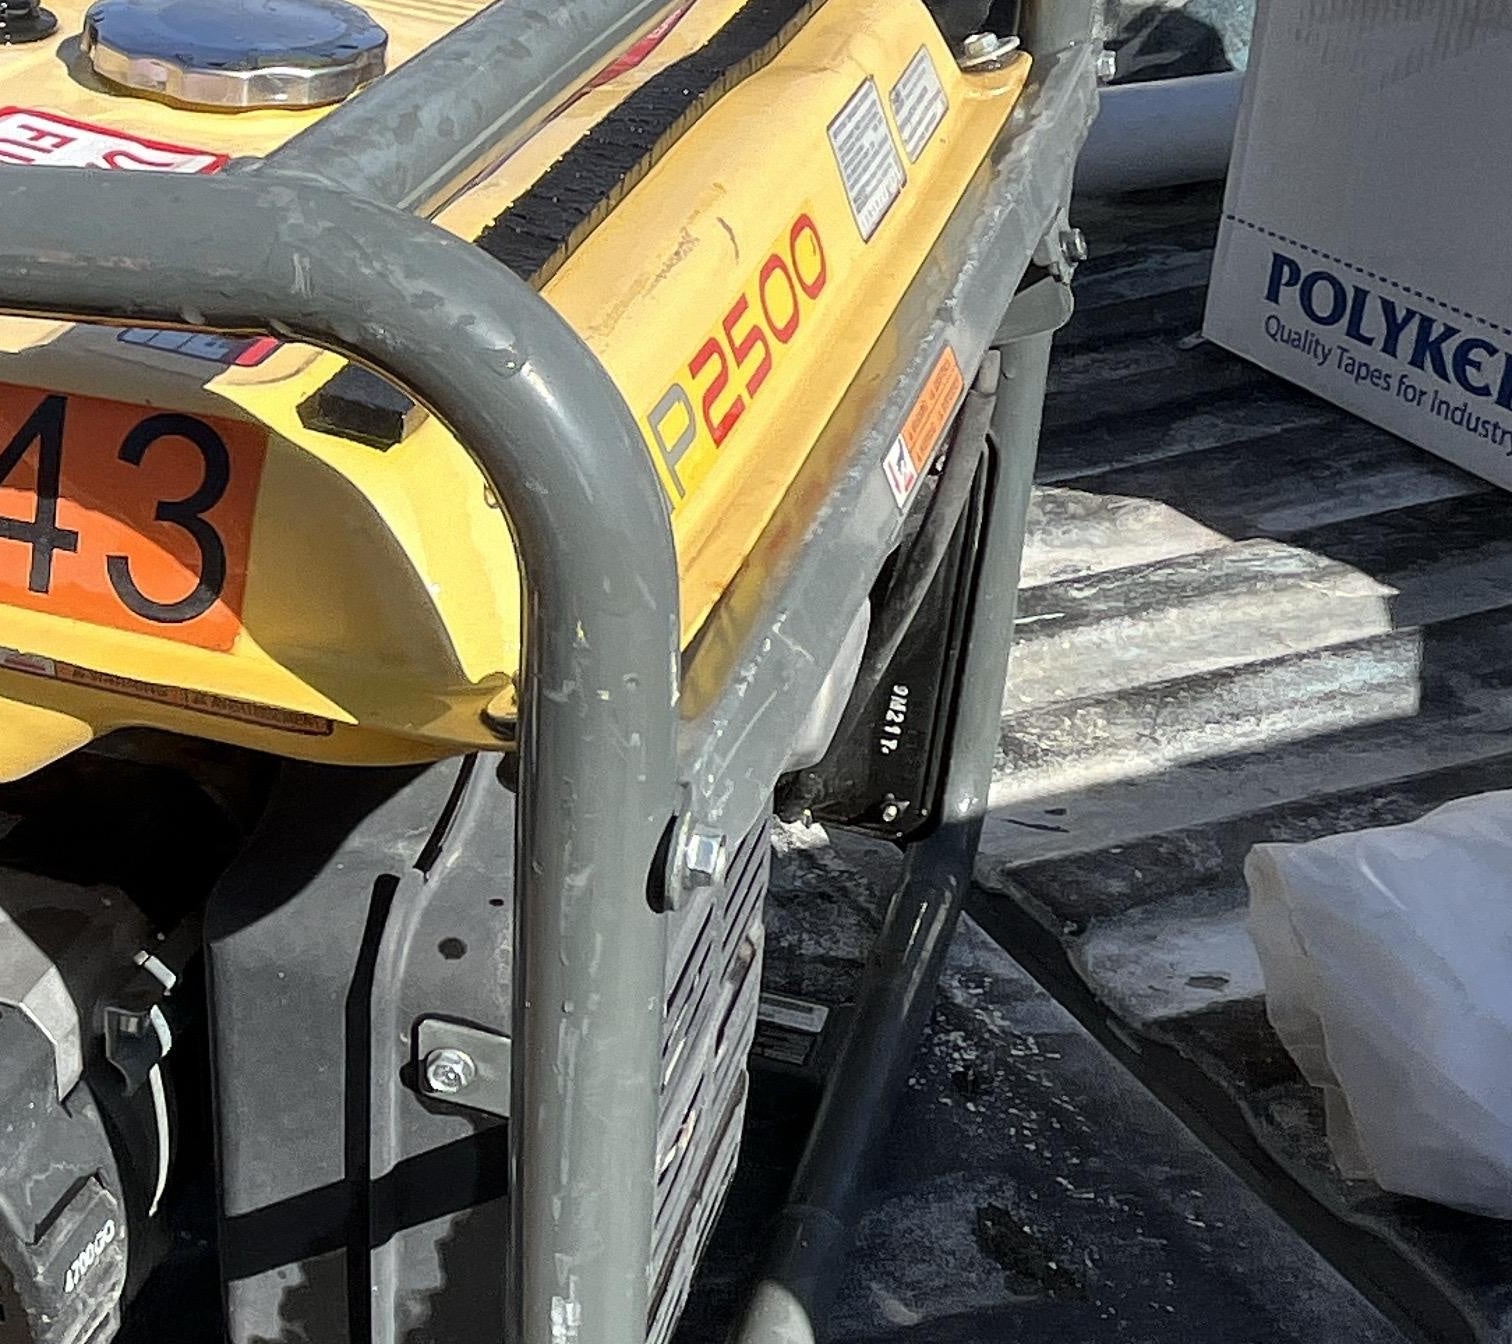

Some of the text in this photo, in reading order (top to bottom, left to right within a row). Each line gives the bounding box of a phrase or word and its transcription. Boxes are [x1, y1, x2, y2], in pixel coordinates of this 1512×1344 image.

[646, 213, 827, 506] P2500
[1265, 314, 1332, 367] Quality
[1337, 344, 1392, 393] Tapes
[1396, 374, 1428, 408] for
